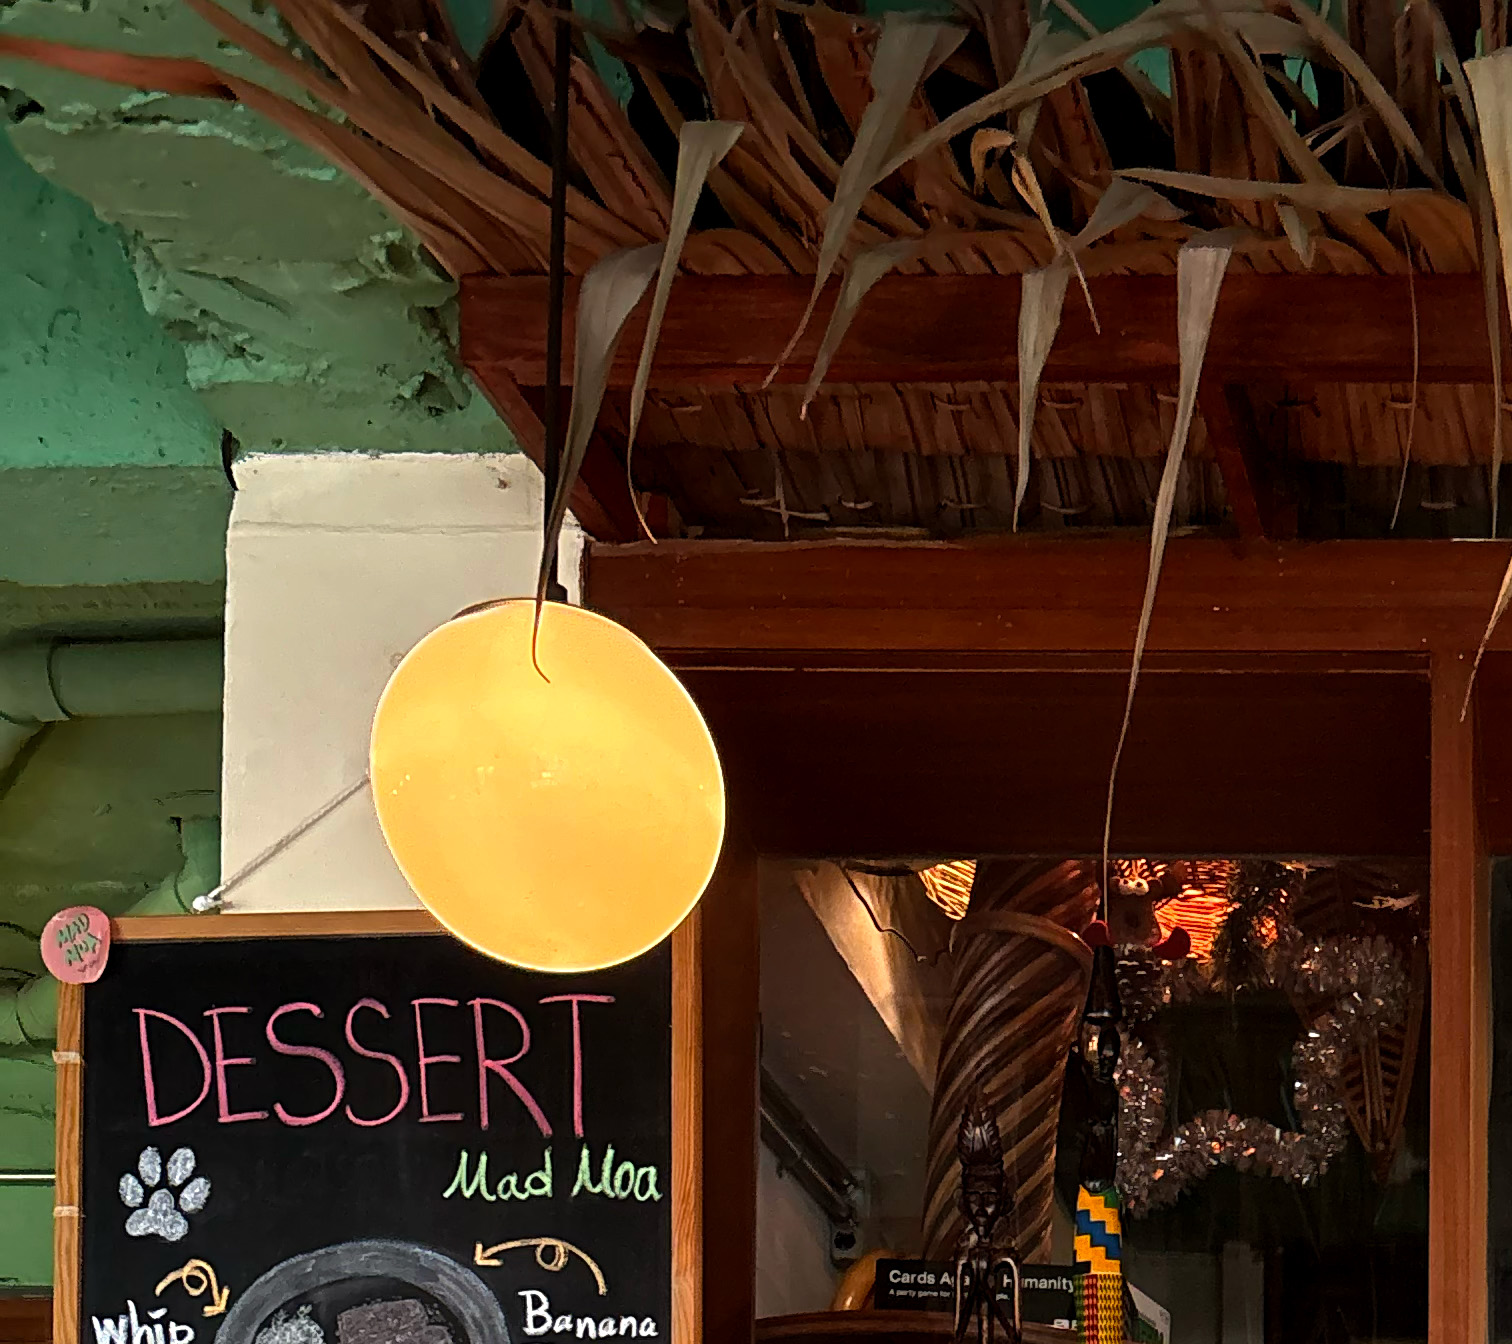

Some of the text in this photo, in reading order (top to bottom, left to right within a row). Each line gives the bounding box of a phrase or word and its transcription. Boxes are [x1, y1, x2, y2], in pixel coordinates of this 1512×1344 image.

[132, 994, 616, 1138] DESSERT
[443, 1144, 663, 1201] Mad Moa
[889, 1269, 936, 1285] Cards
[1002, 1273, 1075, 1294] Hmanity
[517, 1289, 660, 1340] Banana
